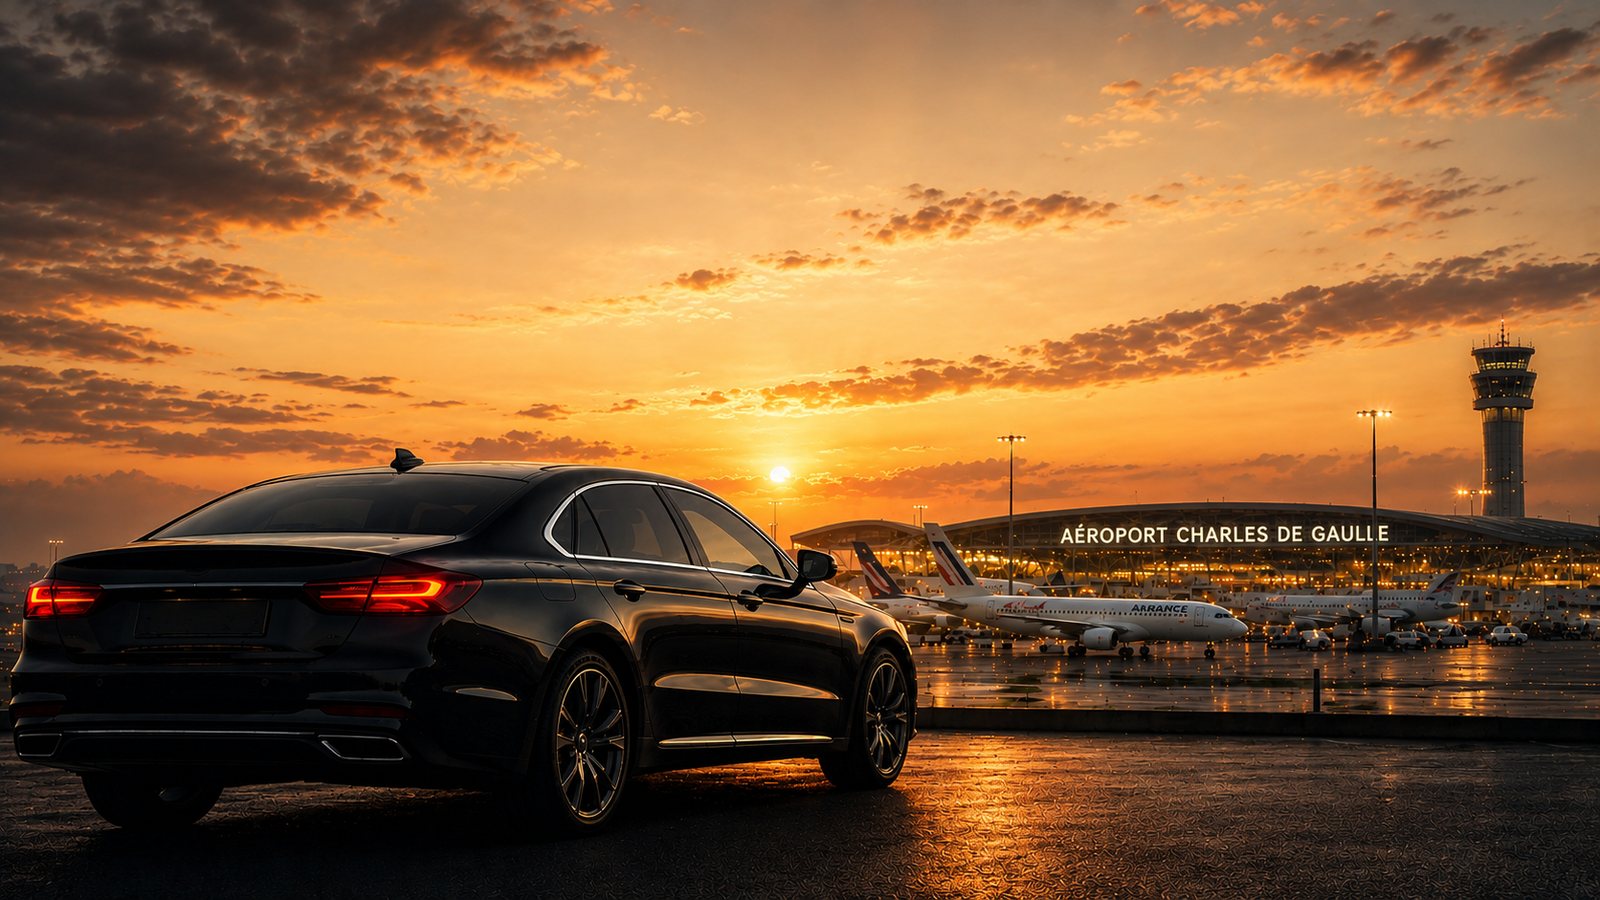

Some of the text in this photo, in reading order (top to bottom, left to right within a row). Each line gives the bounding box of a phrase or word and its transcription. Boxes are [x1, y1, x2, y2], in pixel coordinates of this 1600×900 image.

[1060, 523, 1389, 544] AÉROPORT CHARLES DE GAULLE
